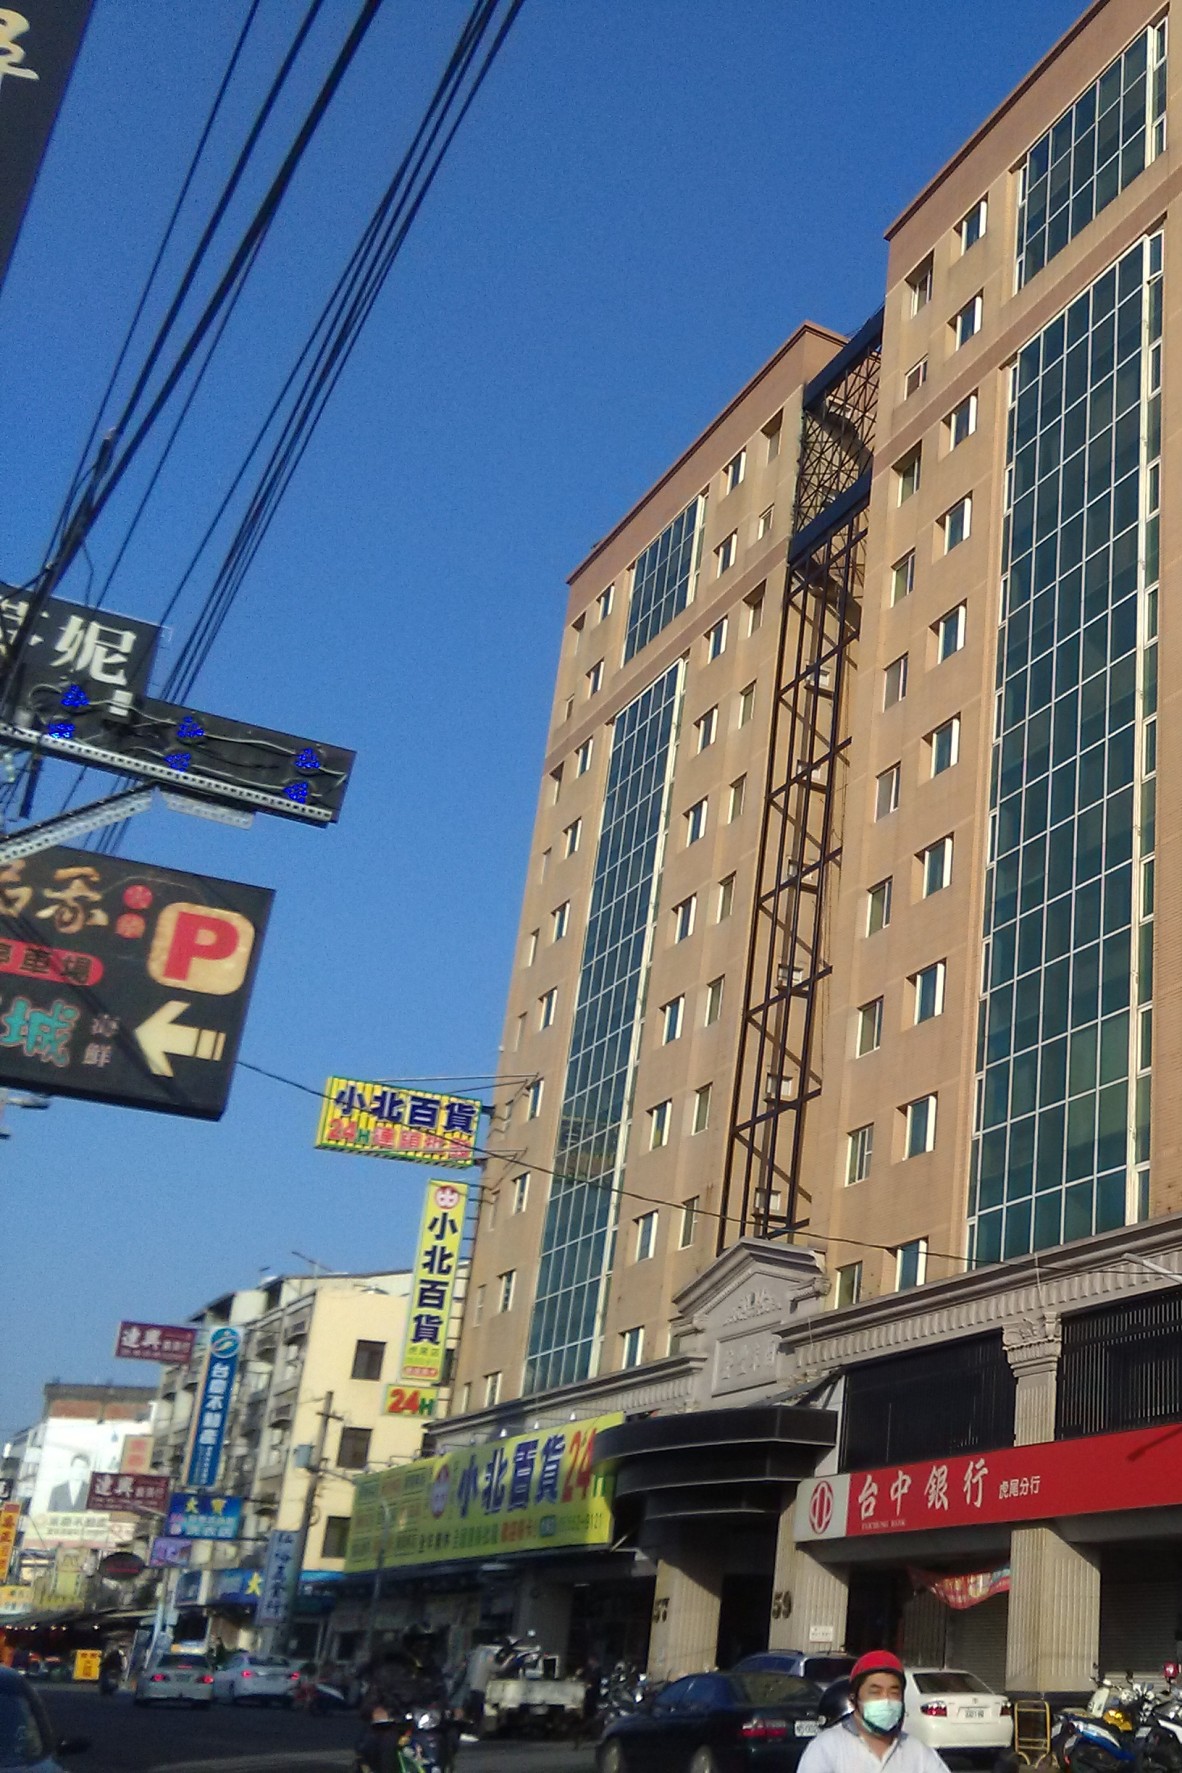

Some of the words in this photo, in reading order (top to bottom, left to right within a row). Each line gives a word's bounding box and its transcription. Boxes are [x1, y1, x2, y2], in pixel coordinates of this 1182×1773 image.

[161, 910, 241, 982] P
[335, 1085, 477, 1135] 小北百貨
[409, 1212, 459, 1346] 小北百貨
[387, 1388, 436, 1416] 24H
[456, 1433, 566, 1520] 小北百貨
[857, 1457, 989, 1521] 台中銀行
[998, 1475, 1041, 1500] 虎尾分行
